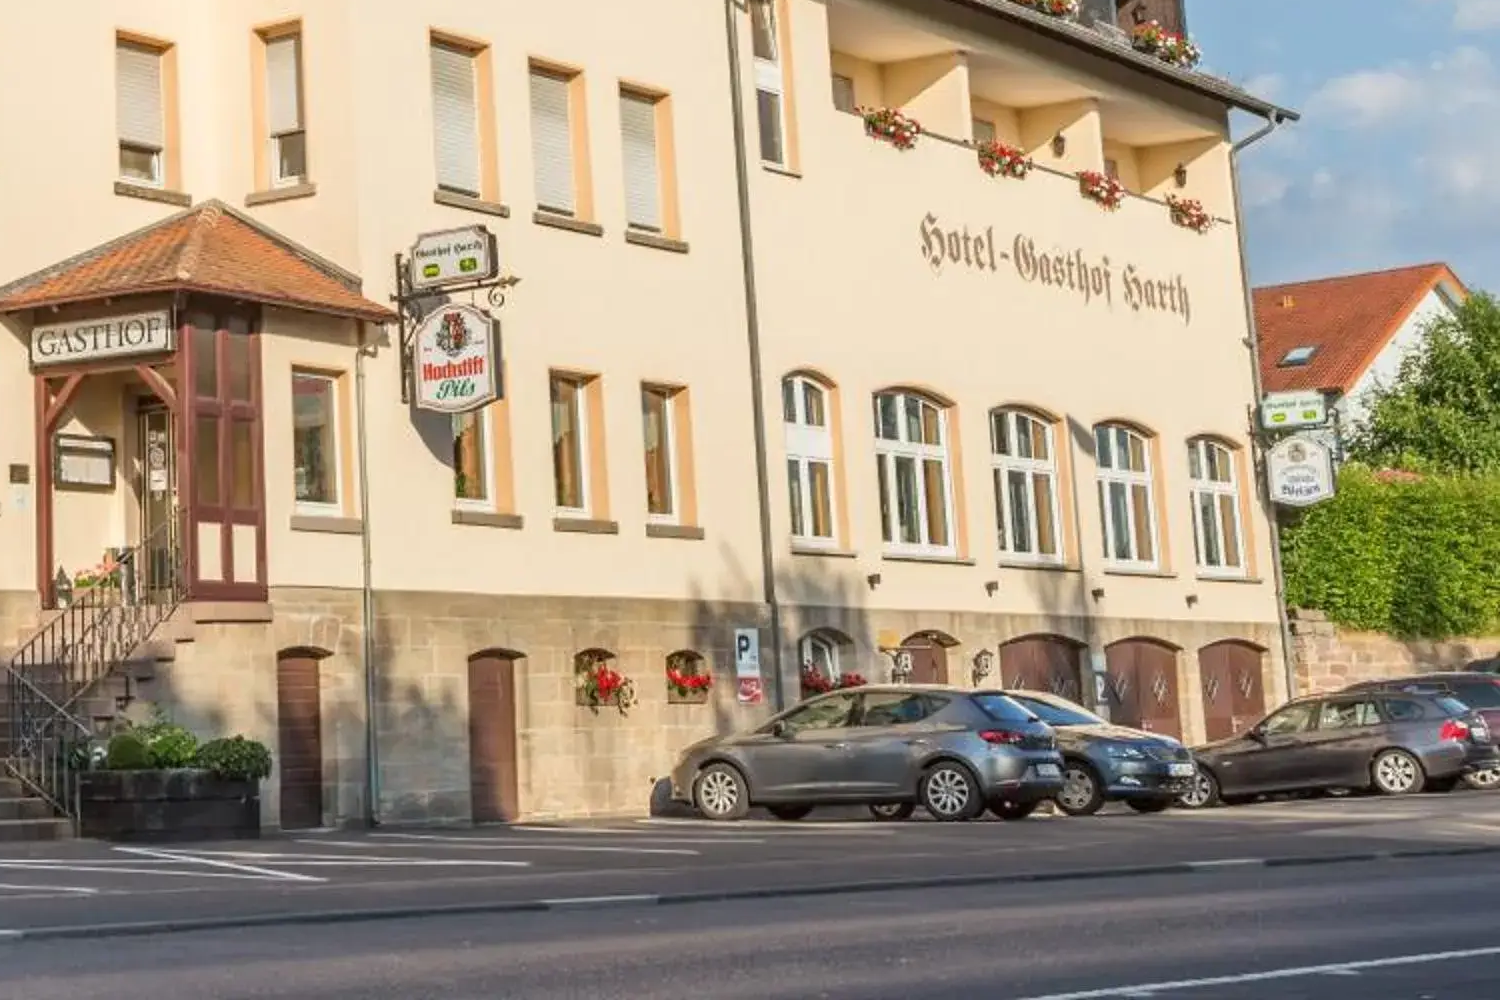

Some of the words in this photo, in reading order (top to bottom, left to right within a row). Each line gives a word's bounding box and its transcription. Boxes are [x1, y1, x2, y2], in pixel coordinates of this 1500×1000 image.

[919, 211, 1112, 306] Hotel-Gasthof
[1122, 263, 1191, 327] Harth
[37, 317, 161, 356] GASTHOF
[435, 378, 475, 400] Pils
[738, 634, 750, 661] P
